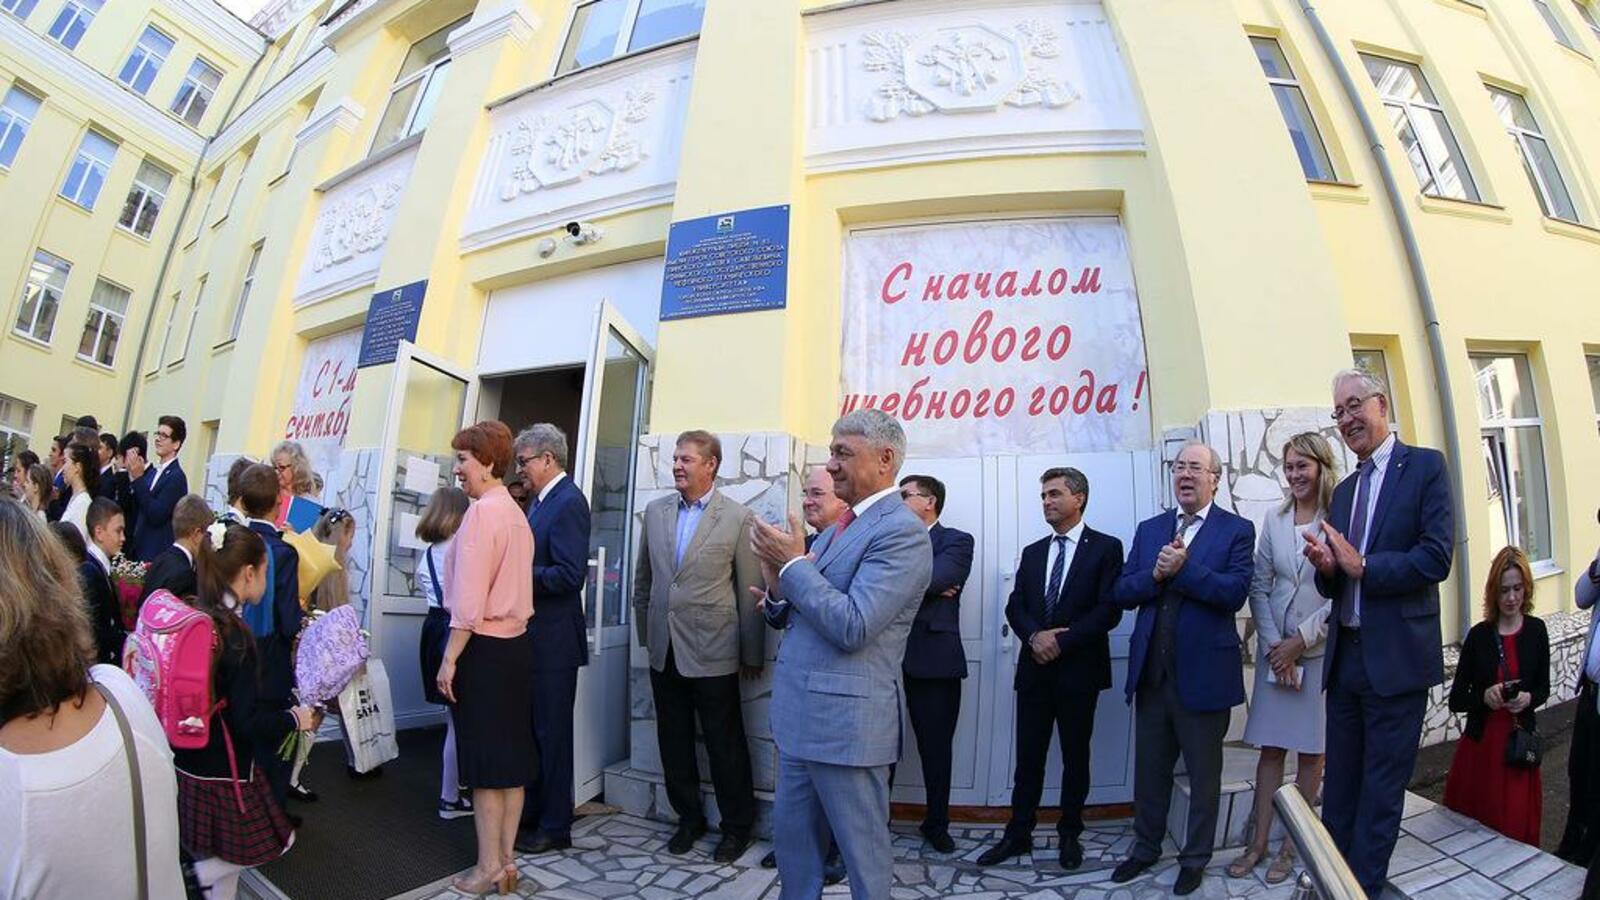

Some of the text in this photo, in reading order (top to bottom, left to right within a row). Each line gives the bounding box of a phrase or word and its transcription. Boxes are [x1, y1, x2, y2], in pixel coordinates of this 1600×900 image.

[881, 262, 1101, 304] С началом
[901, 309, 1072, 366] нового
